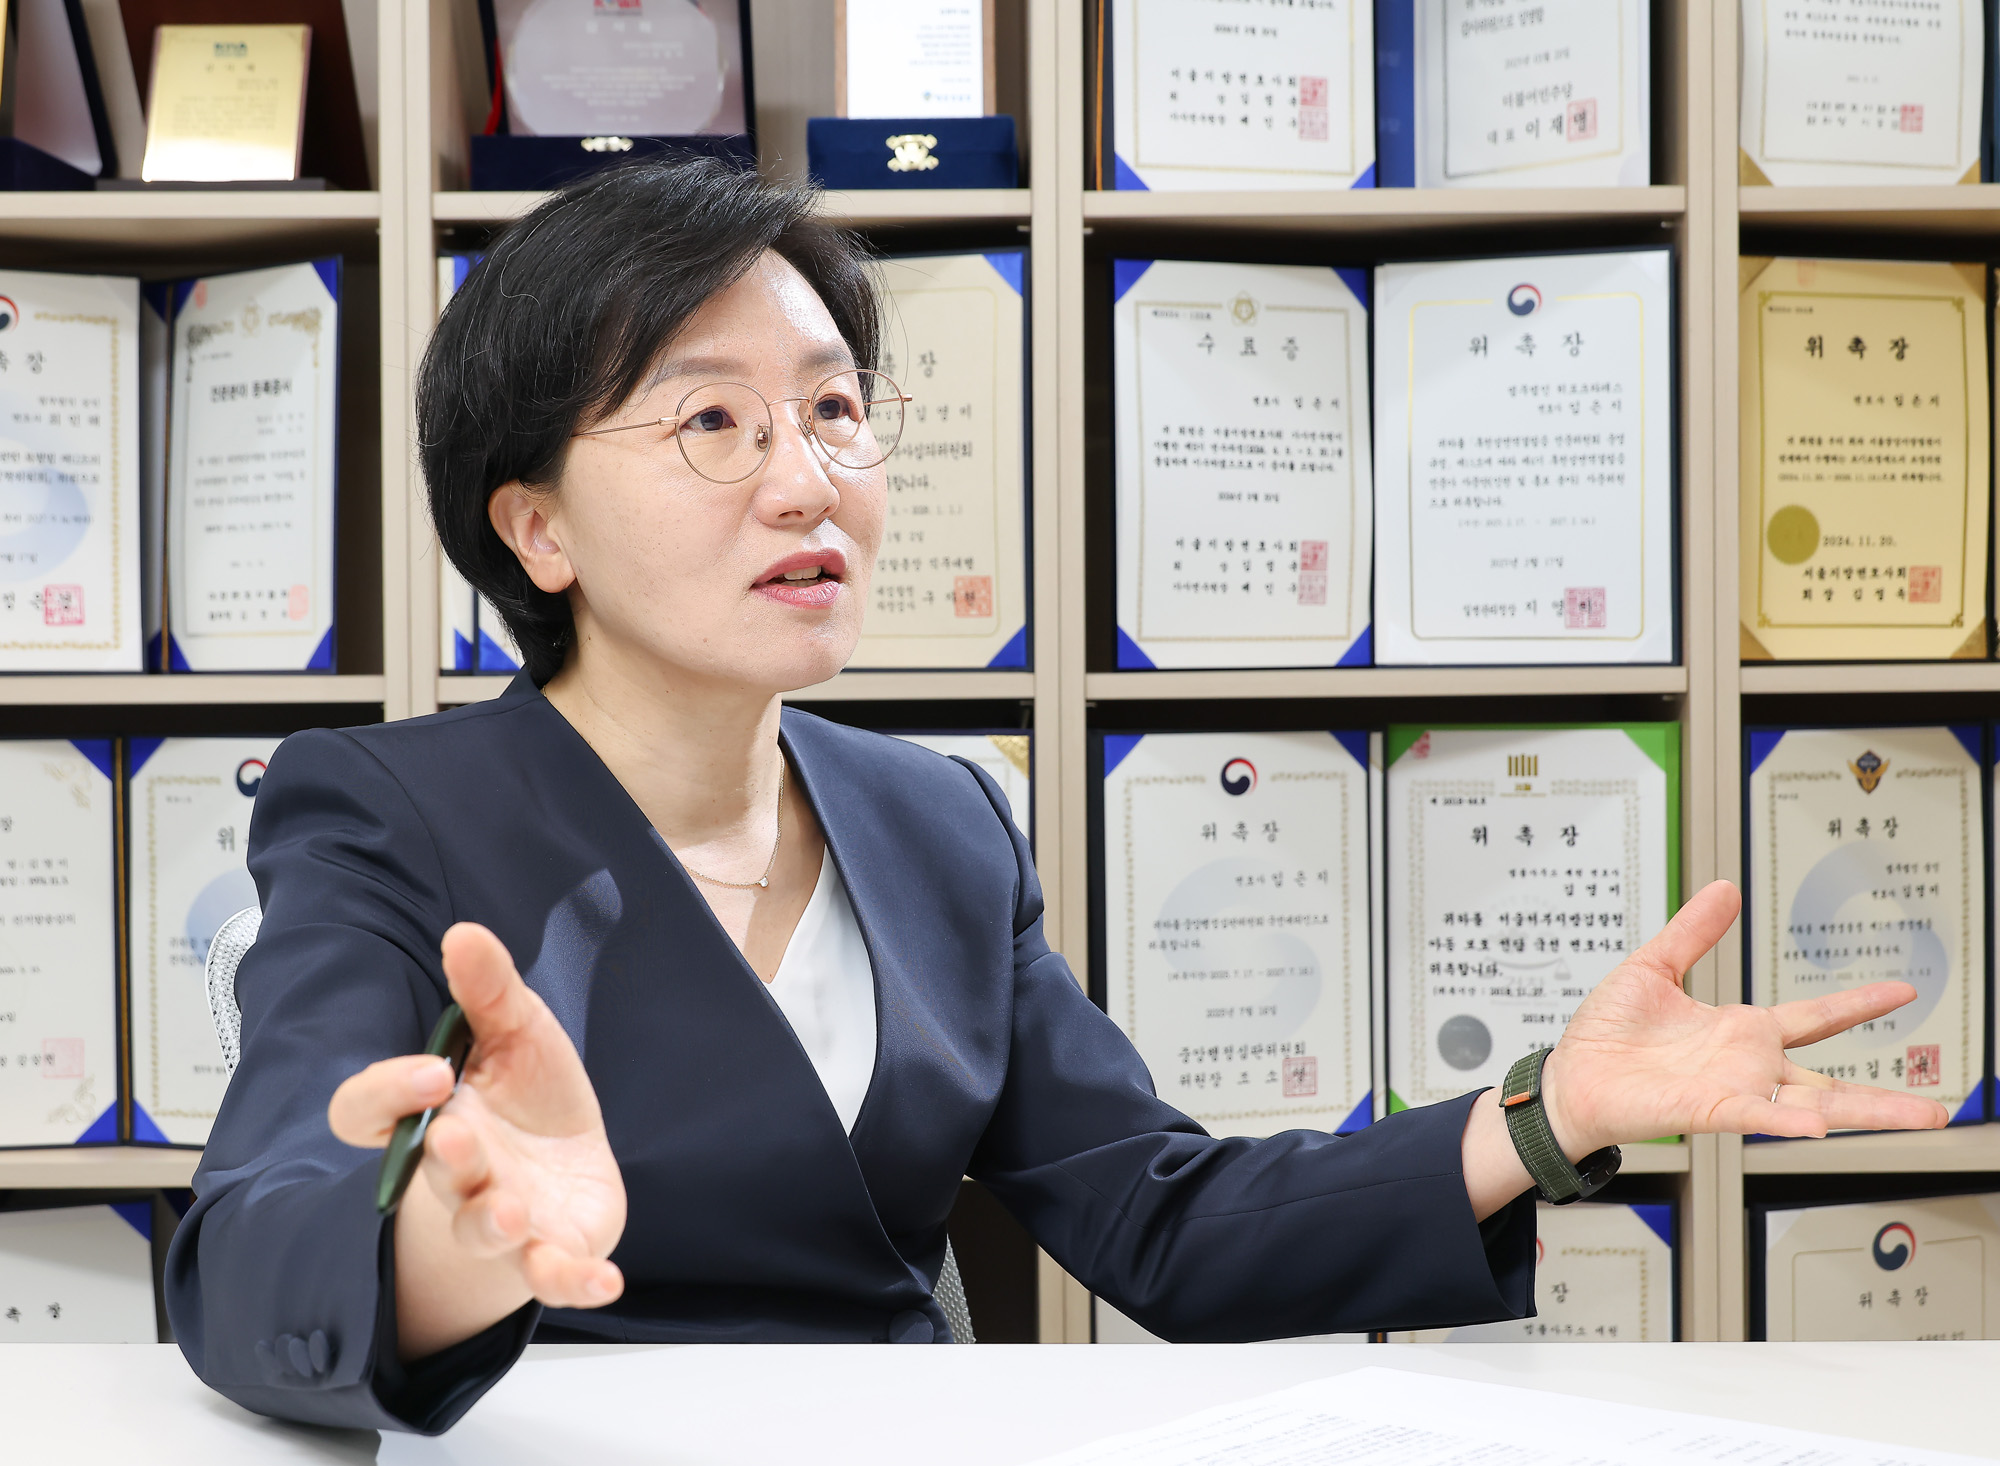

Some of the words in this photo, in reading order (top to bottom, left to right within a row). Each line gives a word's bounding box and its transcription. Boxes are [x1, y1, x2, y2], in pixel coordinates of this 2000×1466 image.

[1502, 80, 1573, 108] 더불어민주당
[1525, 108, 1588, 140] 이재명
[1197, 332, 1300, 361] 수료증
[1468, 330, 1584, 359] 위촉장
[1804, 334, 1909, 362] 위촉장
[1175, 537, 1298, 553] 서울지방변호사회
[1802, 565, 1907, 581] 서울지방변호사회
[1201, 820, 1280, 844] 위촉장
[1471, 824, 1580, 848] 위촉장
[1827, 816, 1900, 839] 위촉장
[1442, 910, 1482, 928] 귀하를
[1498, 910, 1624, 928] 서울서부지방검찰청
[1428, 936, 1455, 953] 아동
[1464, 938, 1491, 953] 보호
[1569, 938, 1626, 953] 변호사로
[1429, 960, 1504, 979] 위촉합니다.
[1178, 1041, 1306, 1064] 중앙행정심판위원회
[1859, 1285, 1928, 1310] 위촉장
